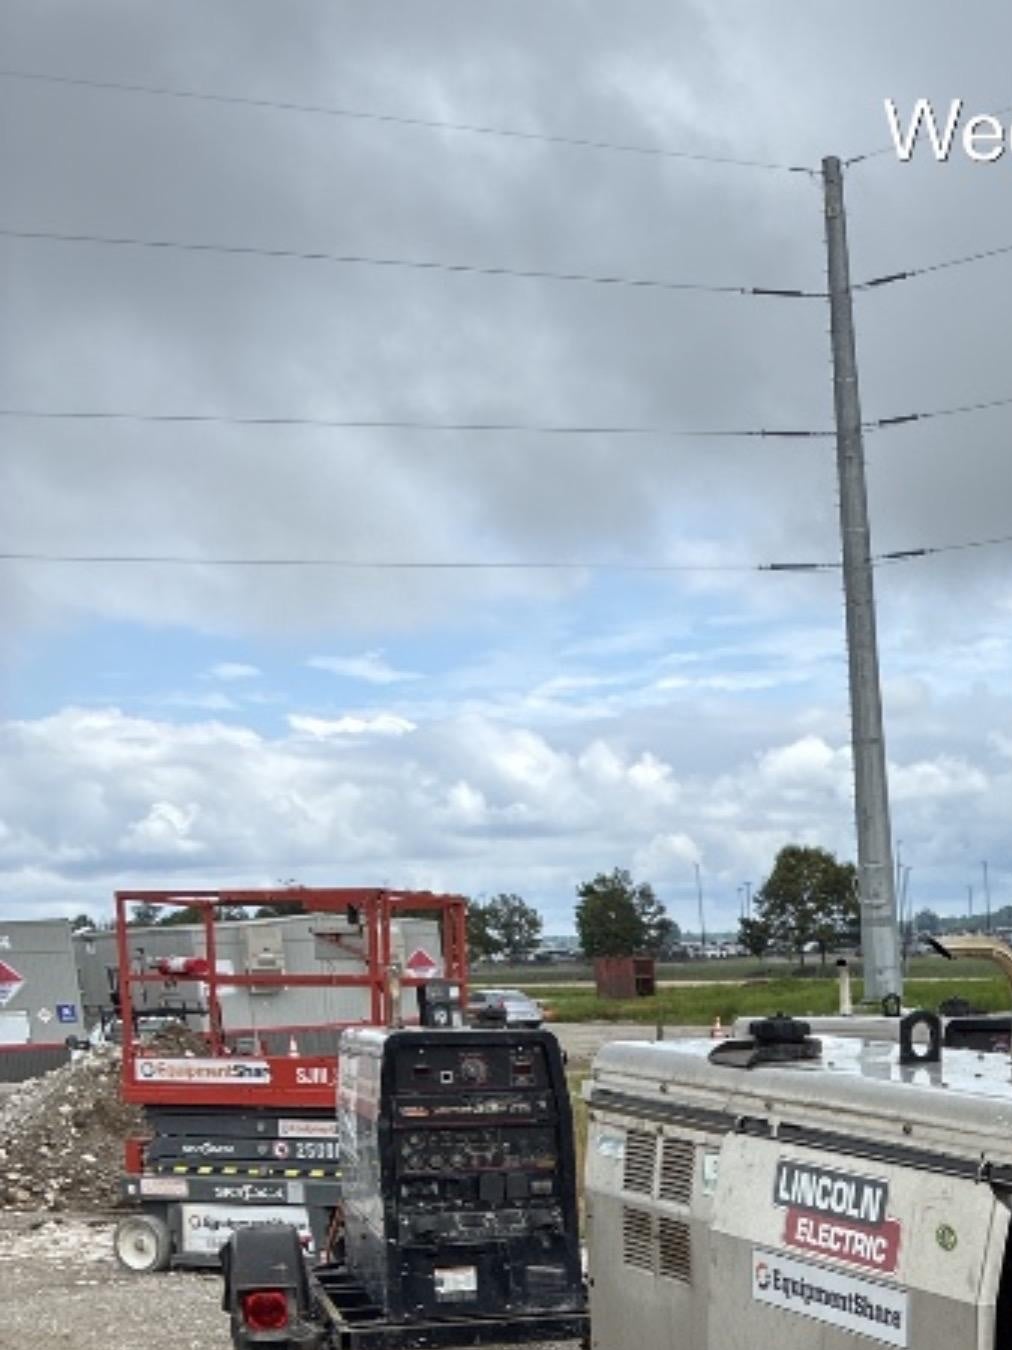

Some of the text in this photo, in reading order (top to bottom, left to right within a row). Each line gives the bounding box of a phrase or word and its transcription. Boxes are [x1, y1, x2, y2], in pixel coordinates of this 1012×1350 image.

[778, 1165, 884, 1223] LINCOLN
[794, 1216, 889, 1264] ELECTRIC
[772, 1267, 903, 1330] EquipmentShare
